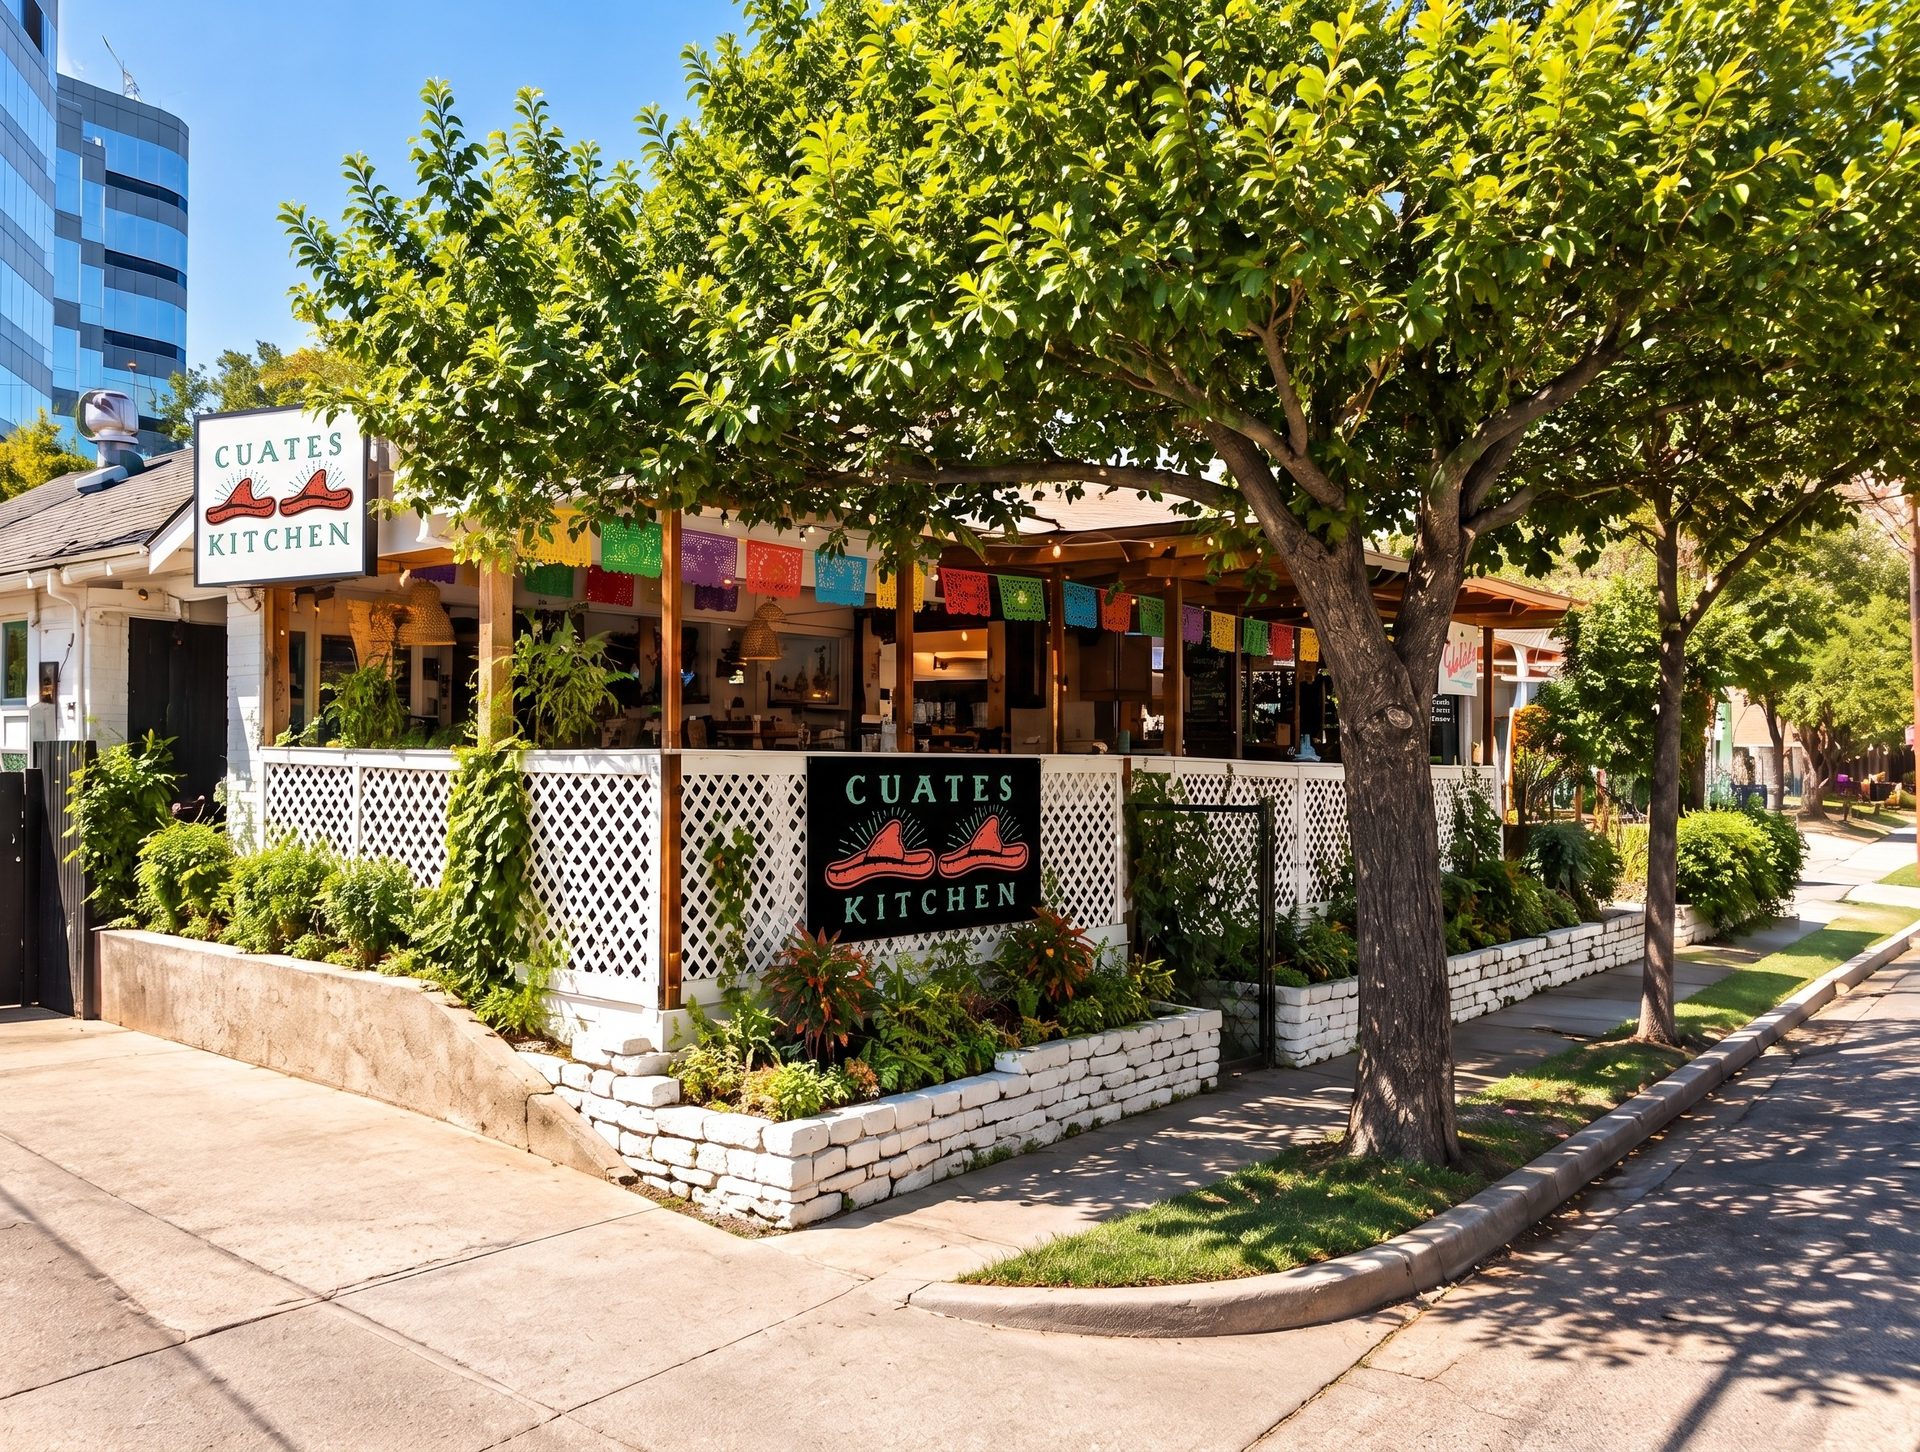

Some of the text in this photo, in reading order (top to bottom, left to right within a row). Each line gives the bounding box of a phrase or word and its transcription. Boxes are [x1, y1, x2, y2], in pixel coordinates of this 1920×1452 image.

[215, 432, 342, 468] CUATES
[208, 522, 350, 556] KITCHEN
[845, 774, 1012, 805] CUATES
[844, 882, 1016, 924] KITCHEN
